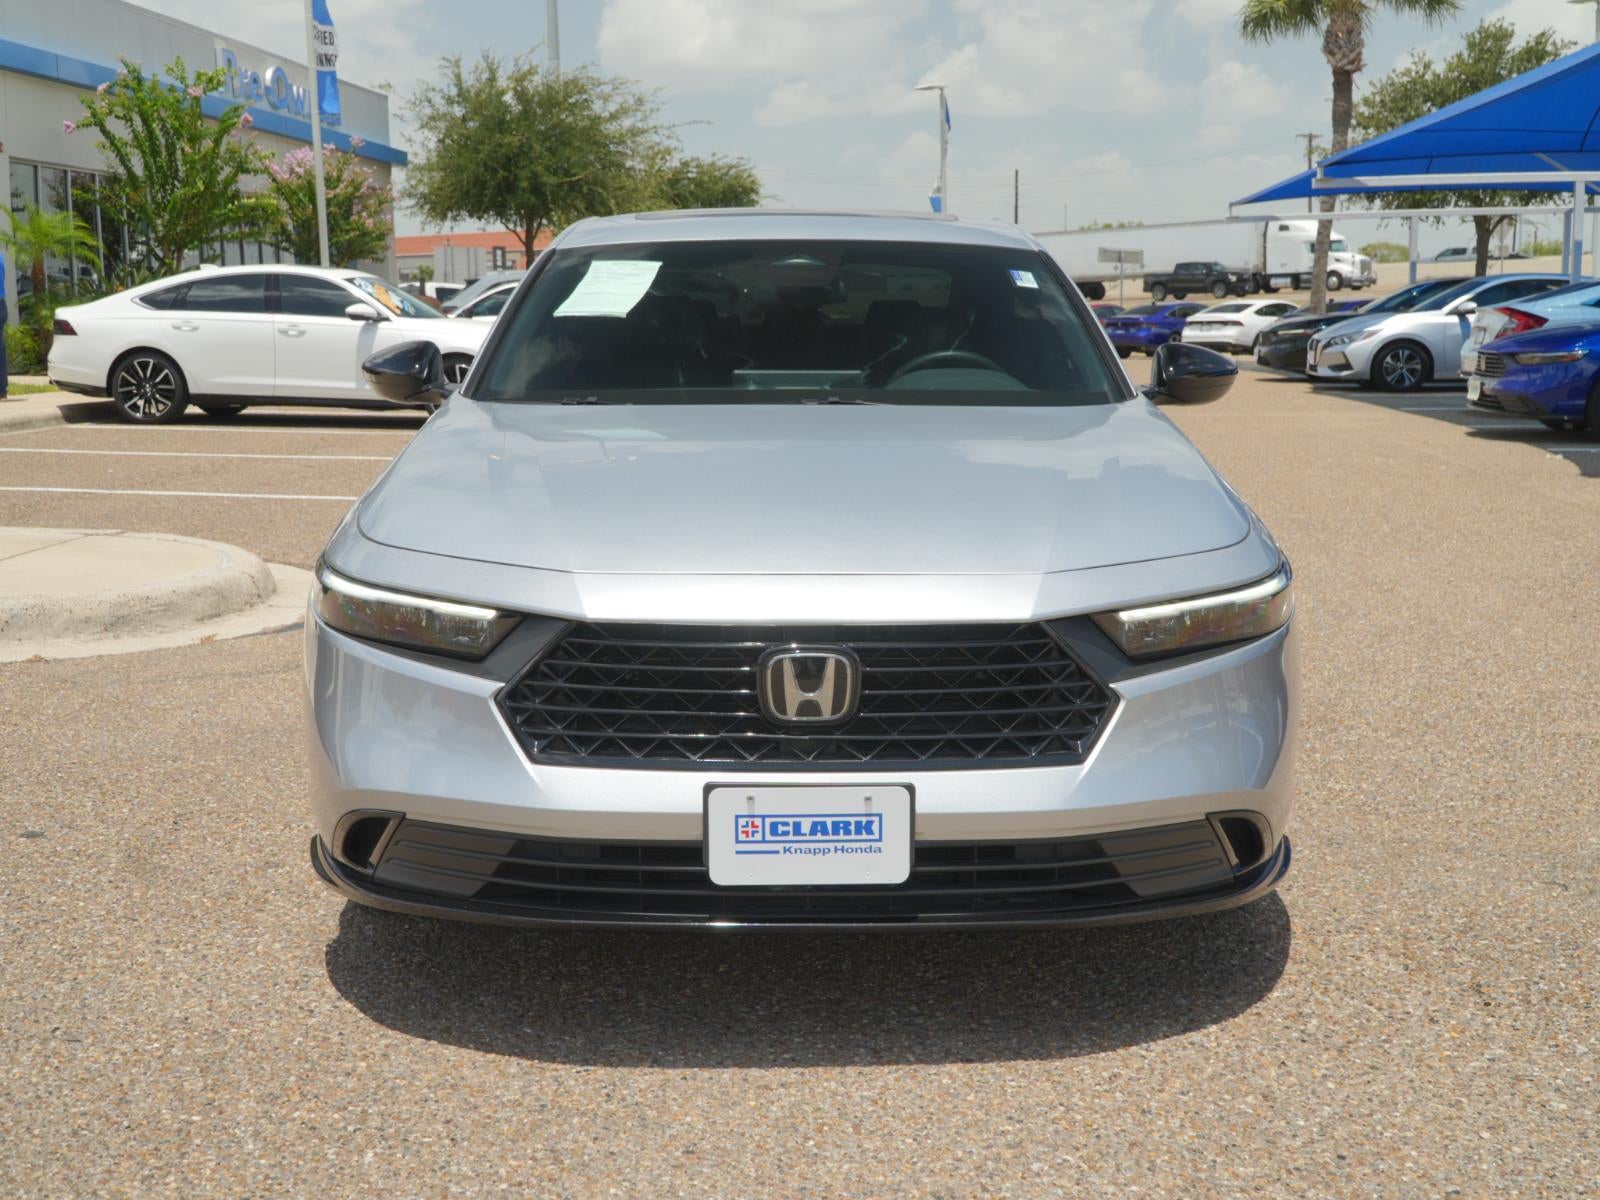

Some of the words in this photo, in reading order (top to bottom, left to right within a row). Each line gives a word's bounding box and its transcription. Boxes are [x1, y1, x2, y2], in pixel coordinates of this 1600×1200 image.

[769, 820, 875, 837] CLARK
[783, 846, 831, 857] Knapp
[834, 845, 882, 855] Honda
